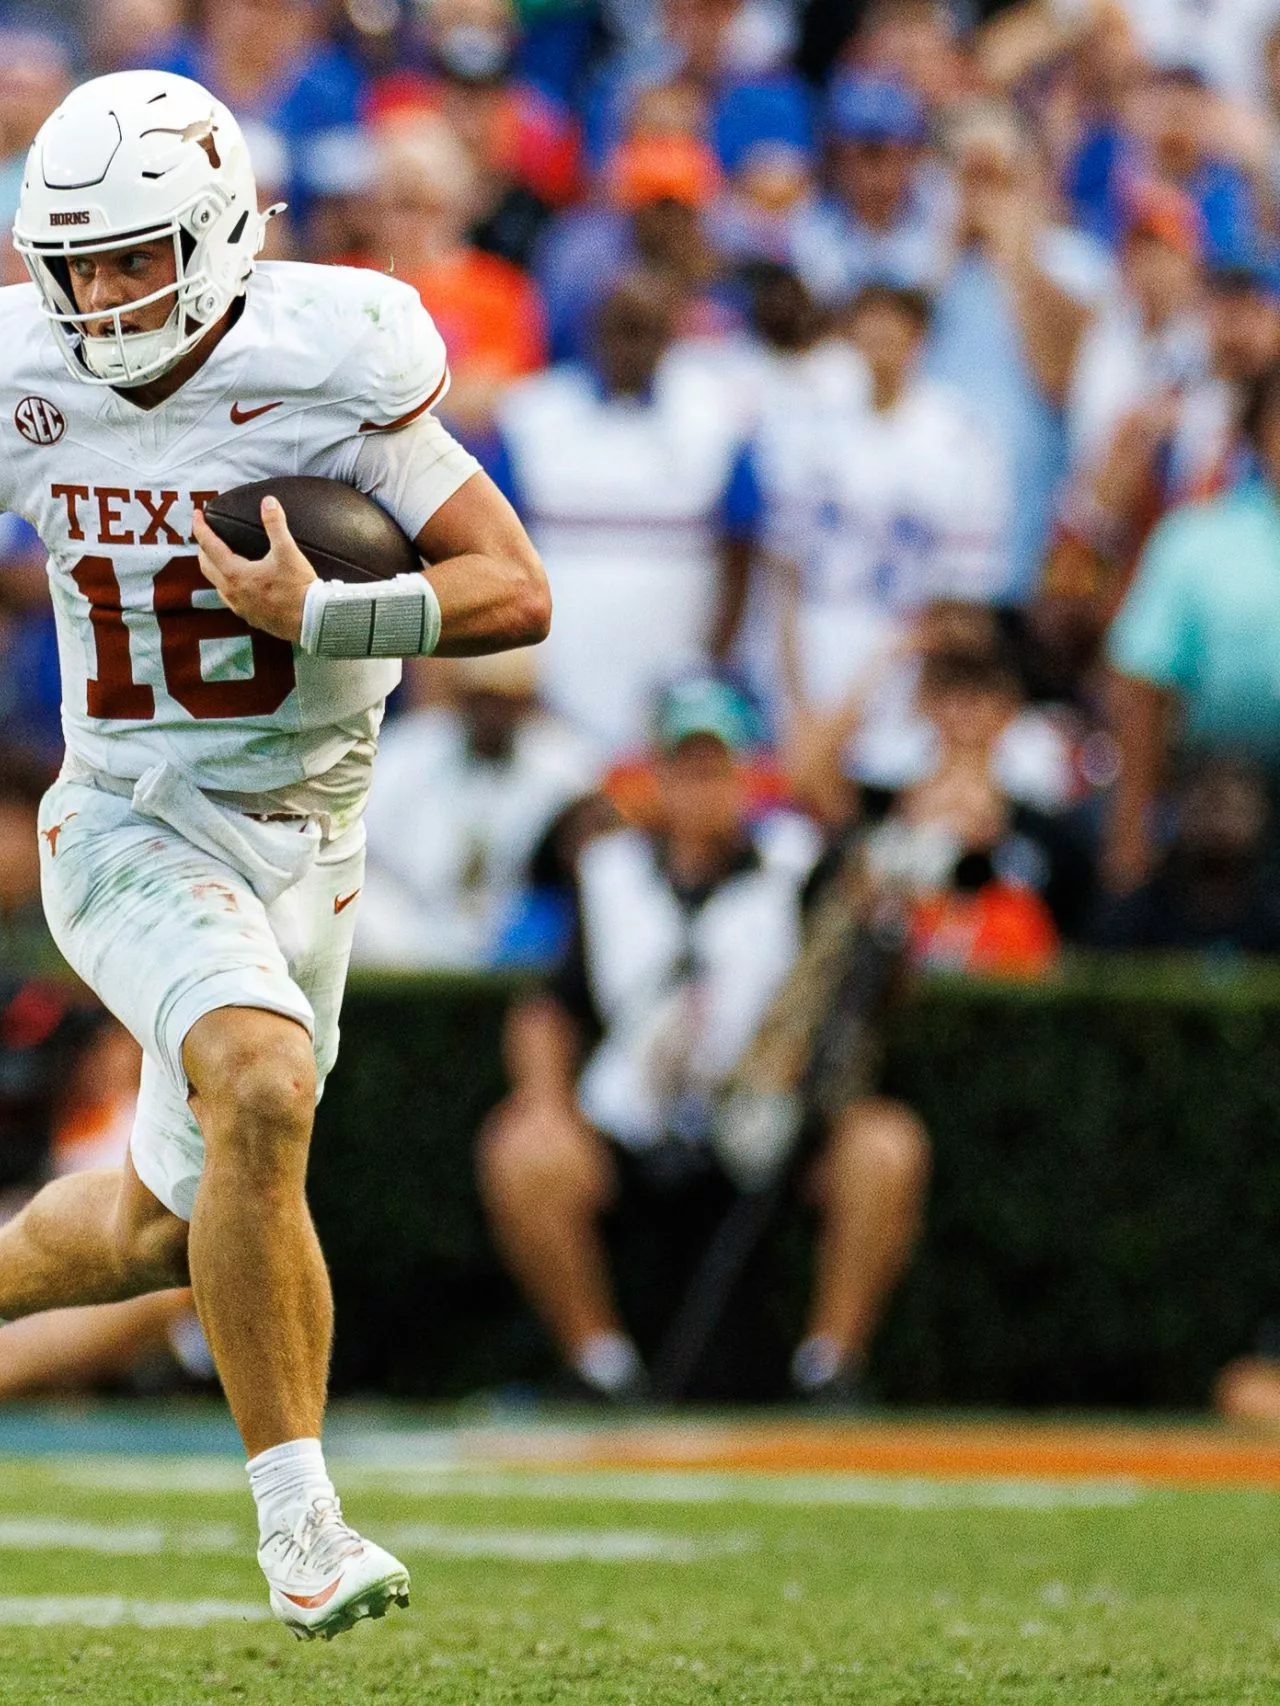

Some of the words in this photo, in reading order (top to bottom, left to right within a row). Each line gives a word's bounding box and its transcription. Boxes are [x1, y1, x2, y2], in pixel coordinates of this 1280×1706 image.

[49, 211, 90, 226] HORNS
[16, 398, 64, 444] SEC
[71, 554, 296, 720] 16
